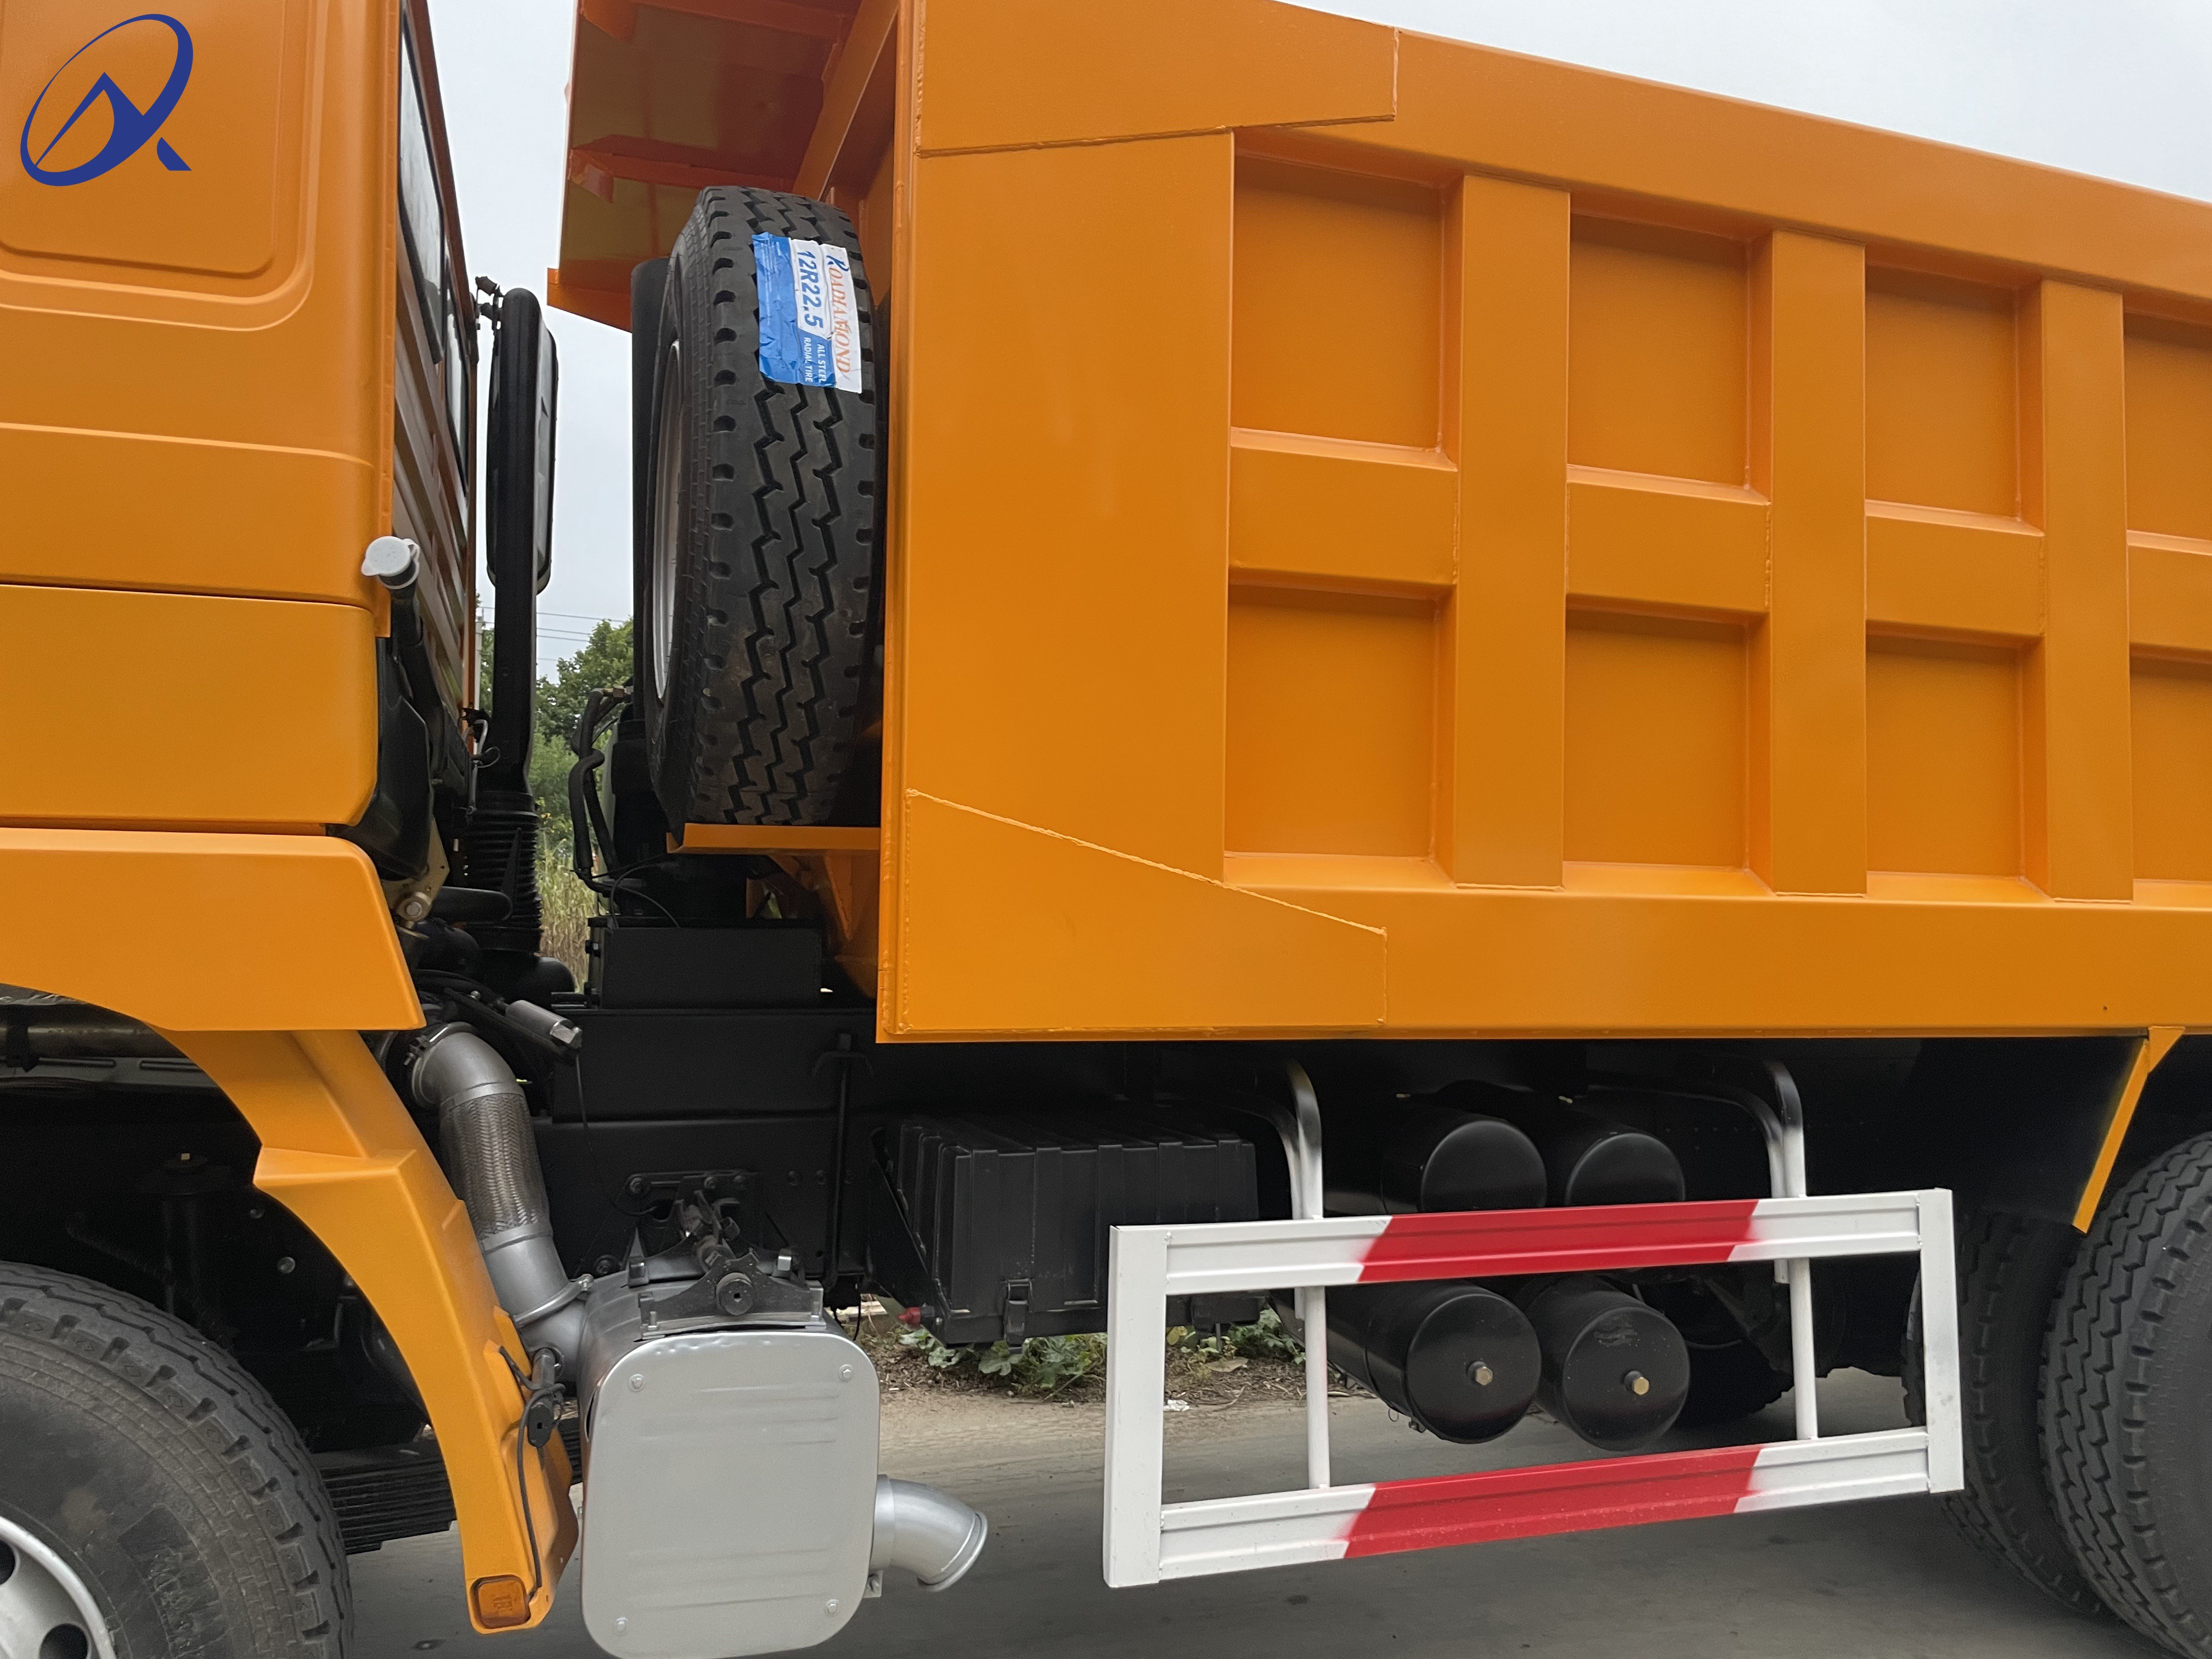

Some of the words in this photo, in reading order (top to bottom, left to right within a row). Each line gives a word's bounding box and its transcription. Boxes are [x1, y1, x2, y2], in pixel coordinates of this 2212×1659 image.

[797, 251, 823, 329] 12R22.5
[803, 337, 812, 363] RADIAL
[805, 364, 814, 383] TIRE
[817, 360, 827, 383] STEEL
